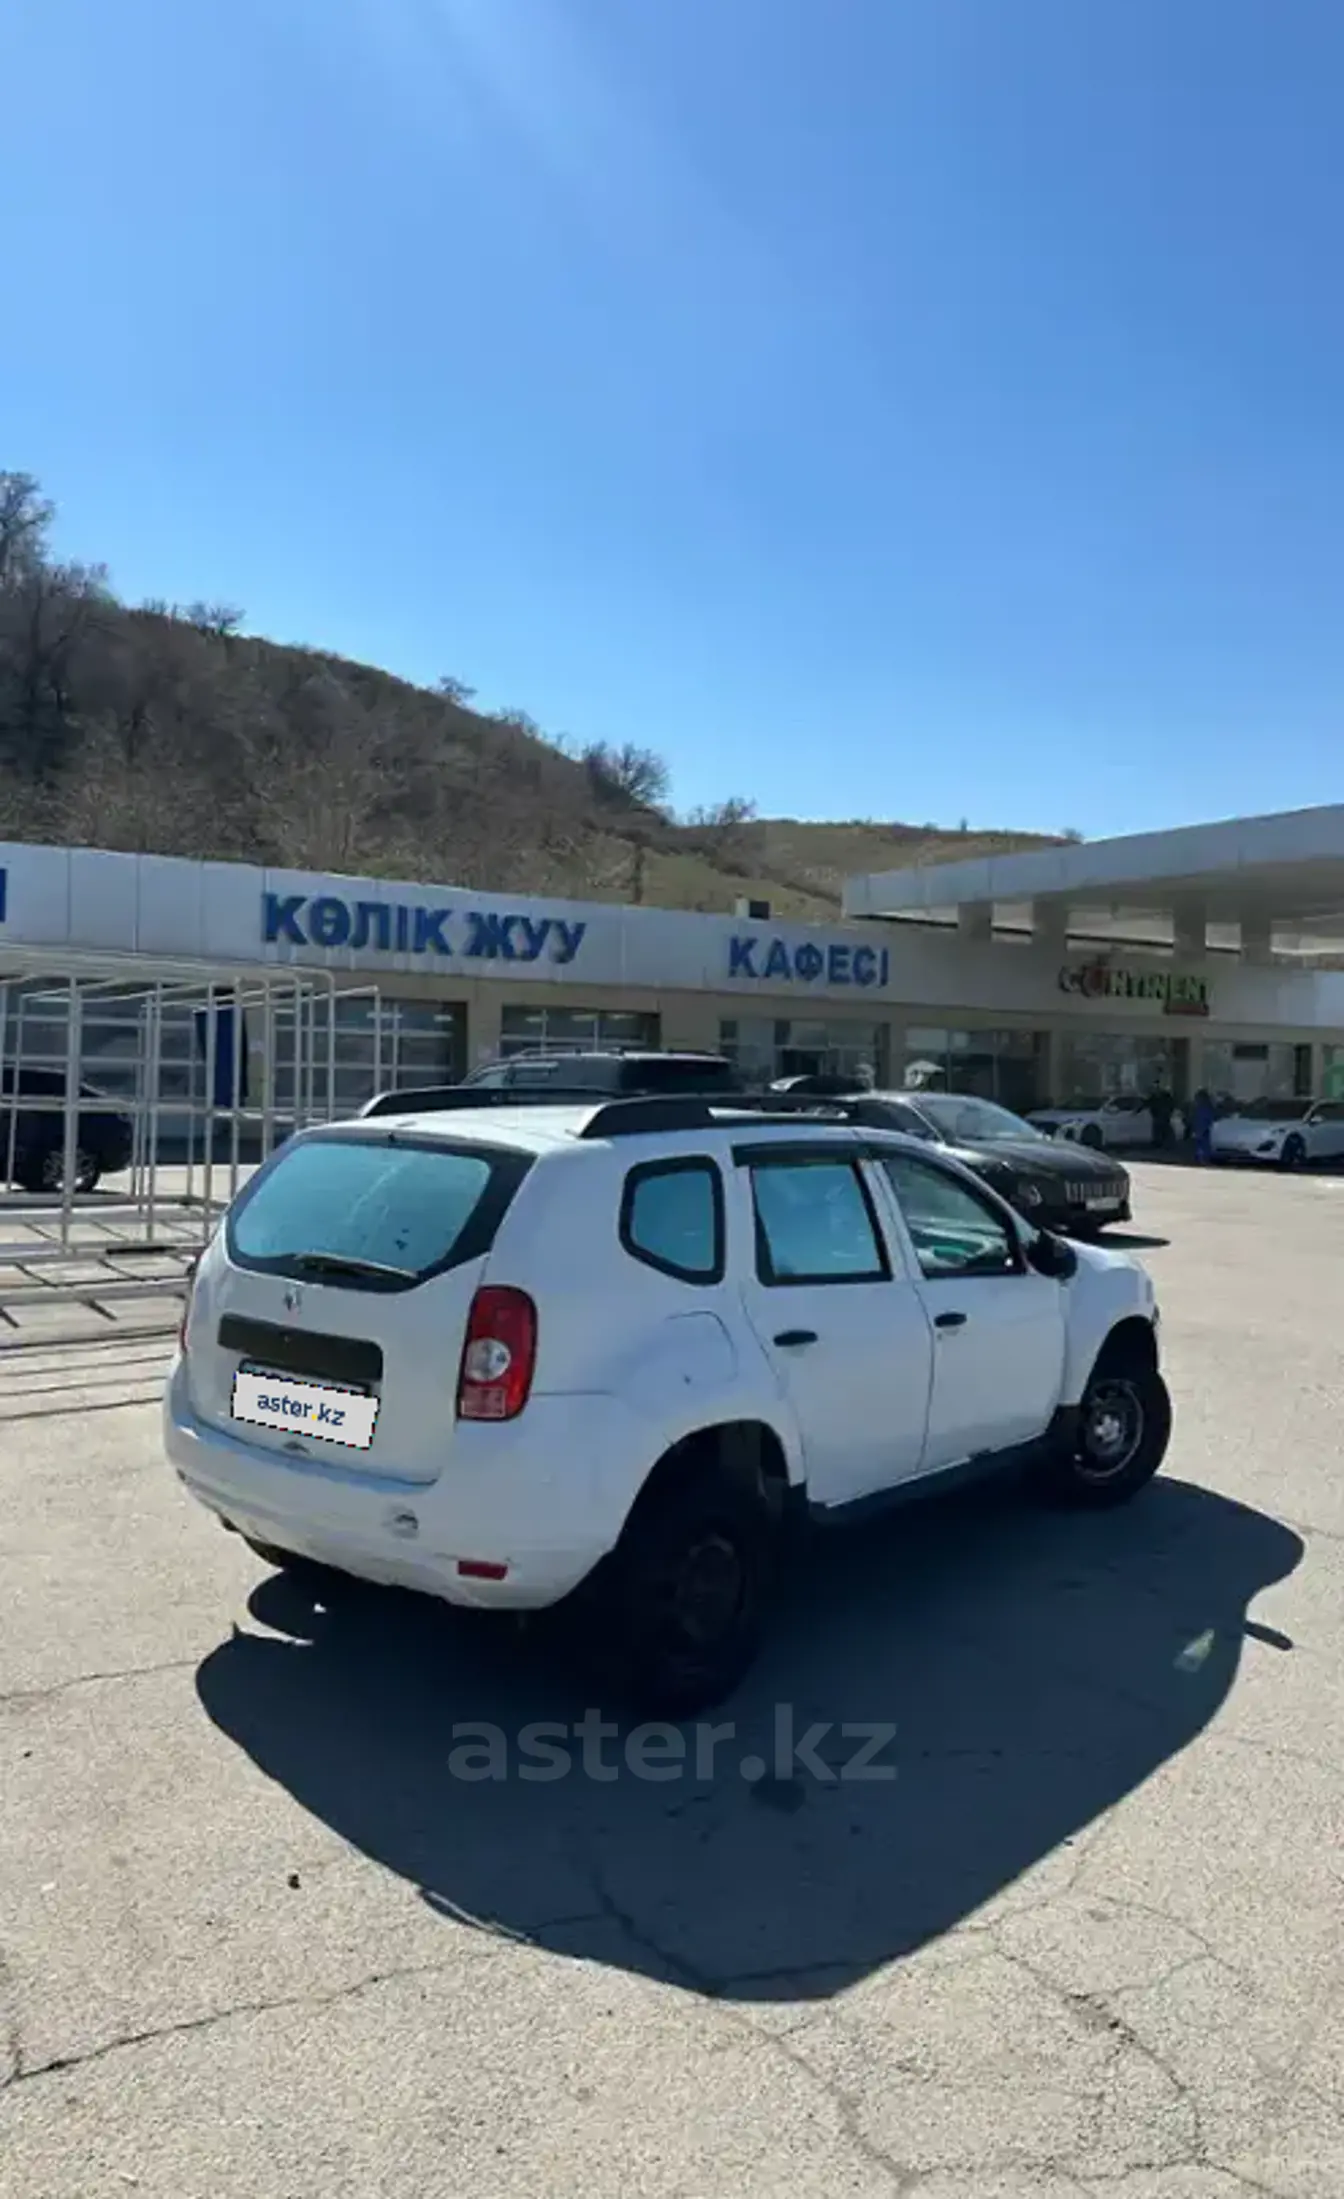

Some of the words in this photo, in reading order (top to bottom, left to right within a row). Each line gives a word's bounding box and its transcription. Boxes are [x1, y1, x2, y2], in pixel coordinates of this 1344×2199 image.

[261, 892, 454, 957] КӨЛІК
[464, 911, 587, 964] ЖУУ
[728, 936, 889, 988] КАФЕСІ
